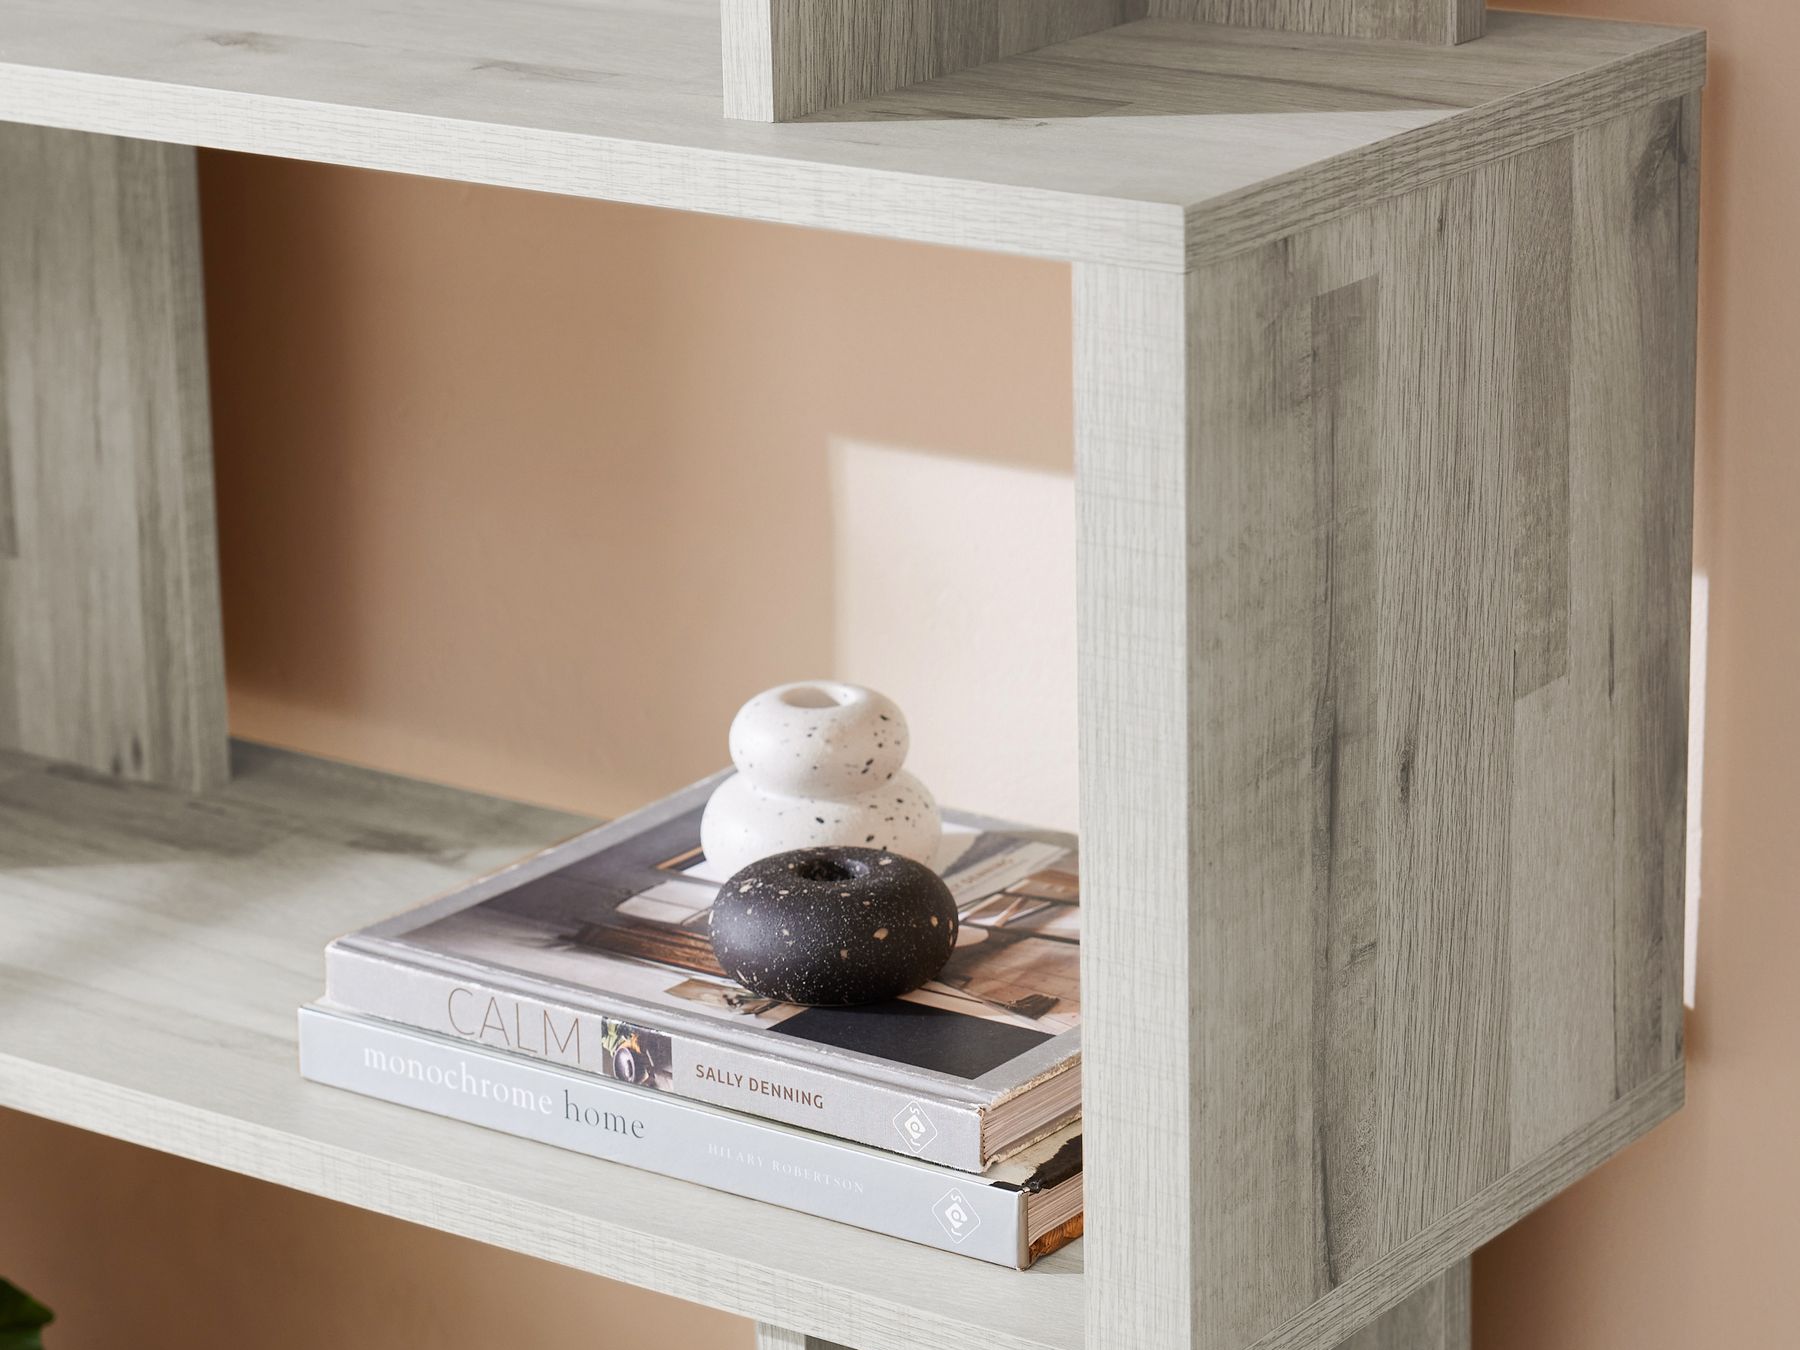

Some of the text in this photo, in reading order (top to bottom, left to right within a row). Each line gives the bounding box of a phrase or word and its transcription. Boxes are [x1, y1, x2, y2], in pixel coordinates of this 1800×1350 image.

[448, 987, 581, 1065] CALM
[363, 1046, 645, 1139] monochrome home
[695, 1063, 824, 1110] SALLY DENNING
[708, 1143, 864, 1193] HILARY ROBERTSON
